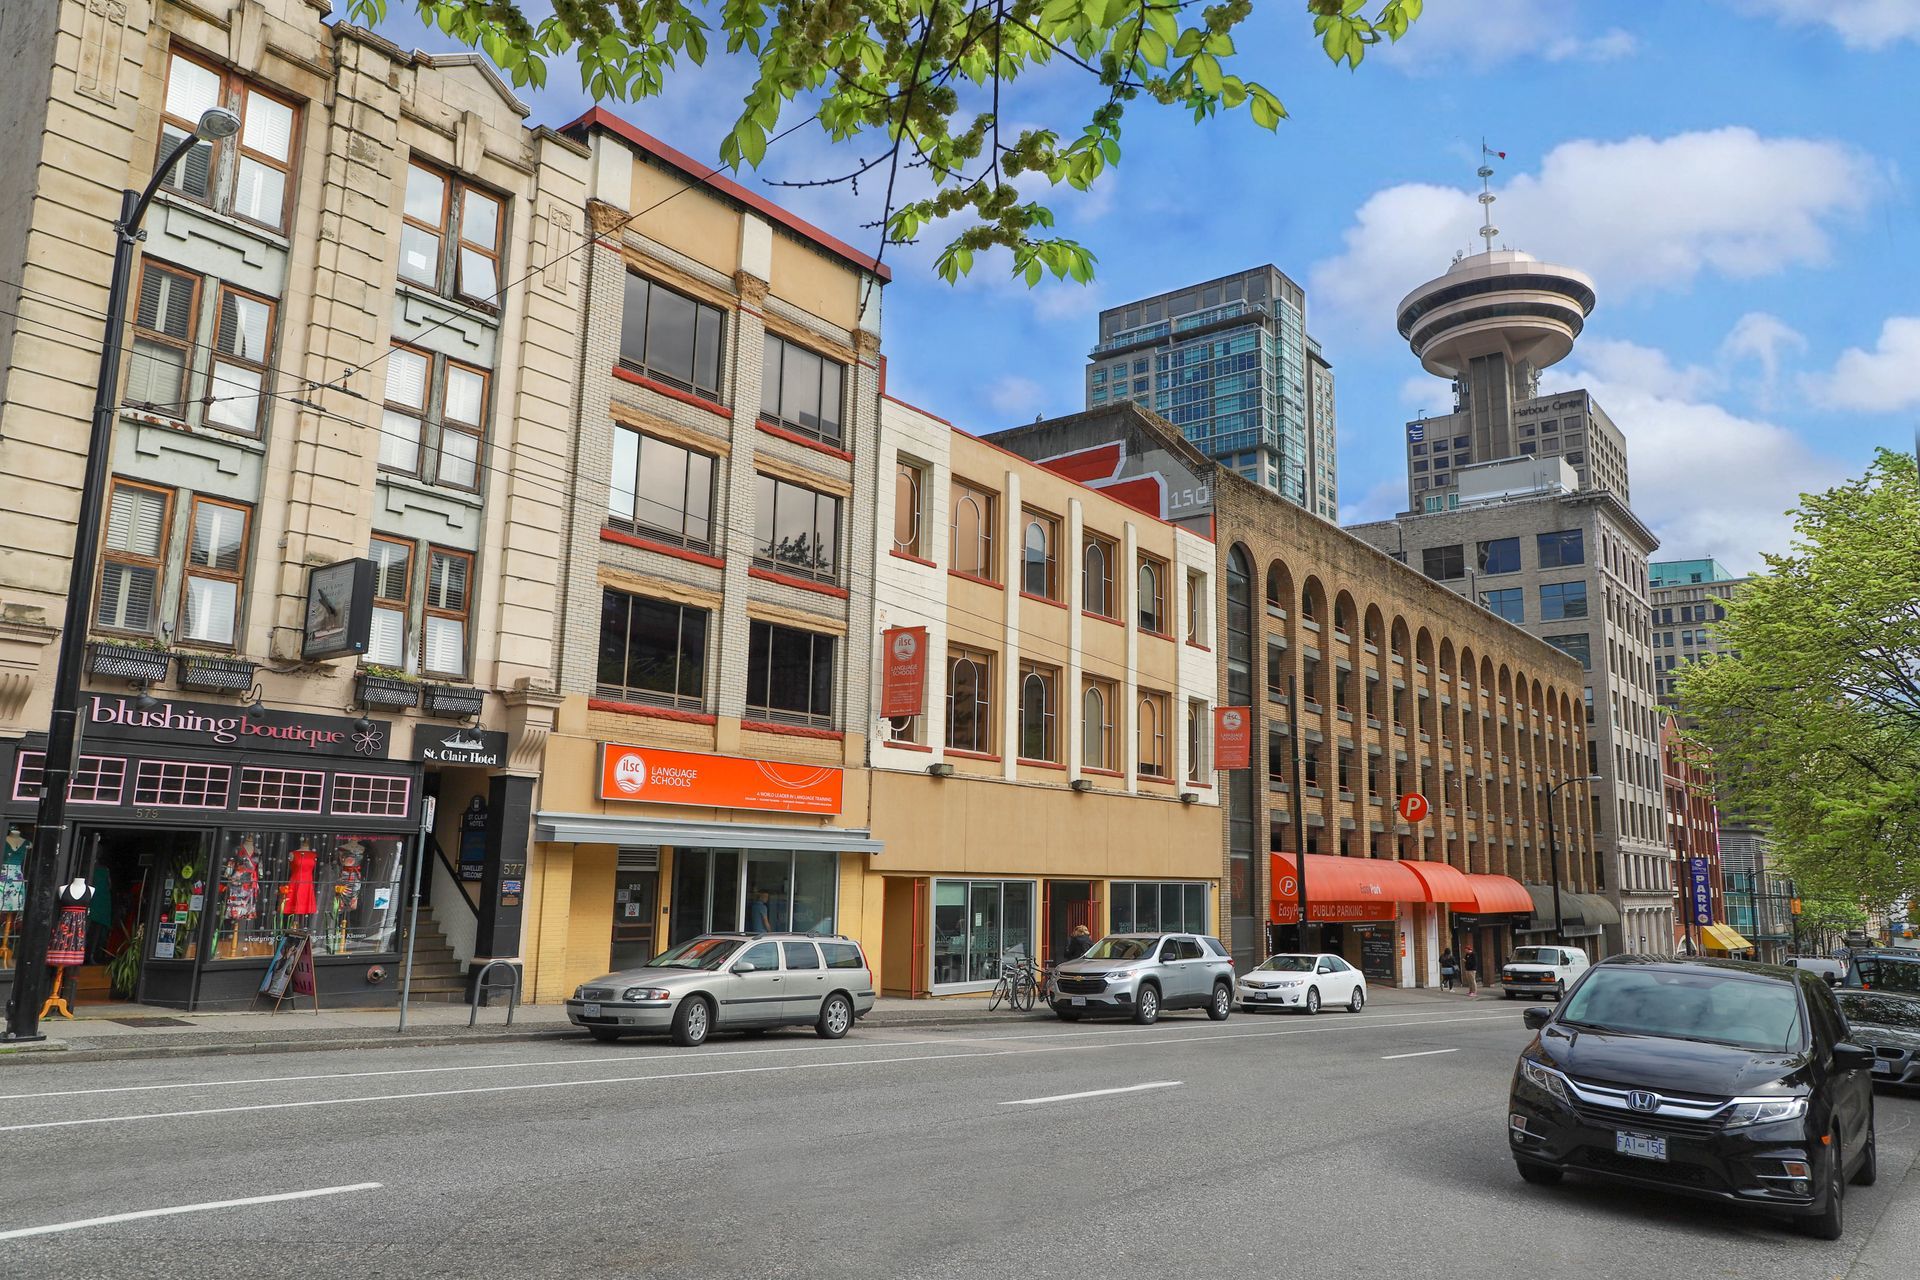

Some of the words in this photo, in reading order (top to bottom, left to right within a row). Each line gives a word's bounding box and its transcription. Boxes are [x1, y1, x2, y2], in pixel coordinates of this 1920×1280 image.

[1513, 404, 1549, 417] Harbour
[1553, 400, 1583, 410] Centre
[1170, 485, 1209, 509] 150
[91, 696, 239, 743] blushing
[240, 716, 345, 748] boutique
[423, 748, 438, 760] St.
[441, 749, 467, 763] Clair
[469, 752, 497, 765] Hotel
[622, 759, 640, 773] ilsc
[651, 766, 698, 779] LANGUAGE
[651, 776, 691, 787] SCHOOLS
[135, 808, 159, 819] 579
[1406, 797, 1421, 817] P
[503, 864, 524, 875] 577
[1695, 875, 1708, 912] PARK
[1312, 905, 1335, 917] PUBLIC
[1336, 905, 1363, 917] PARKING
